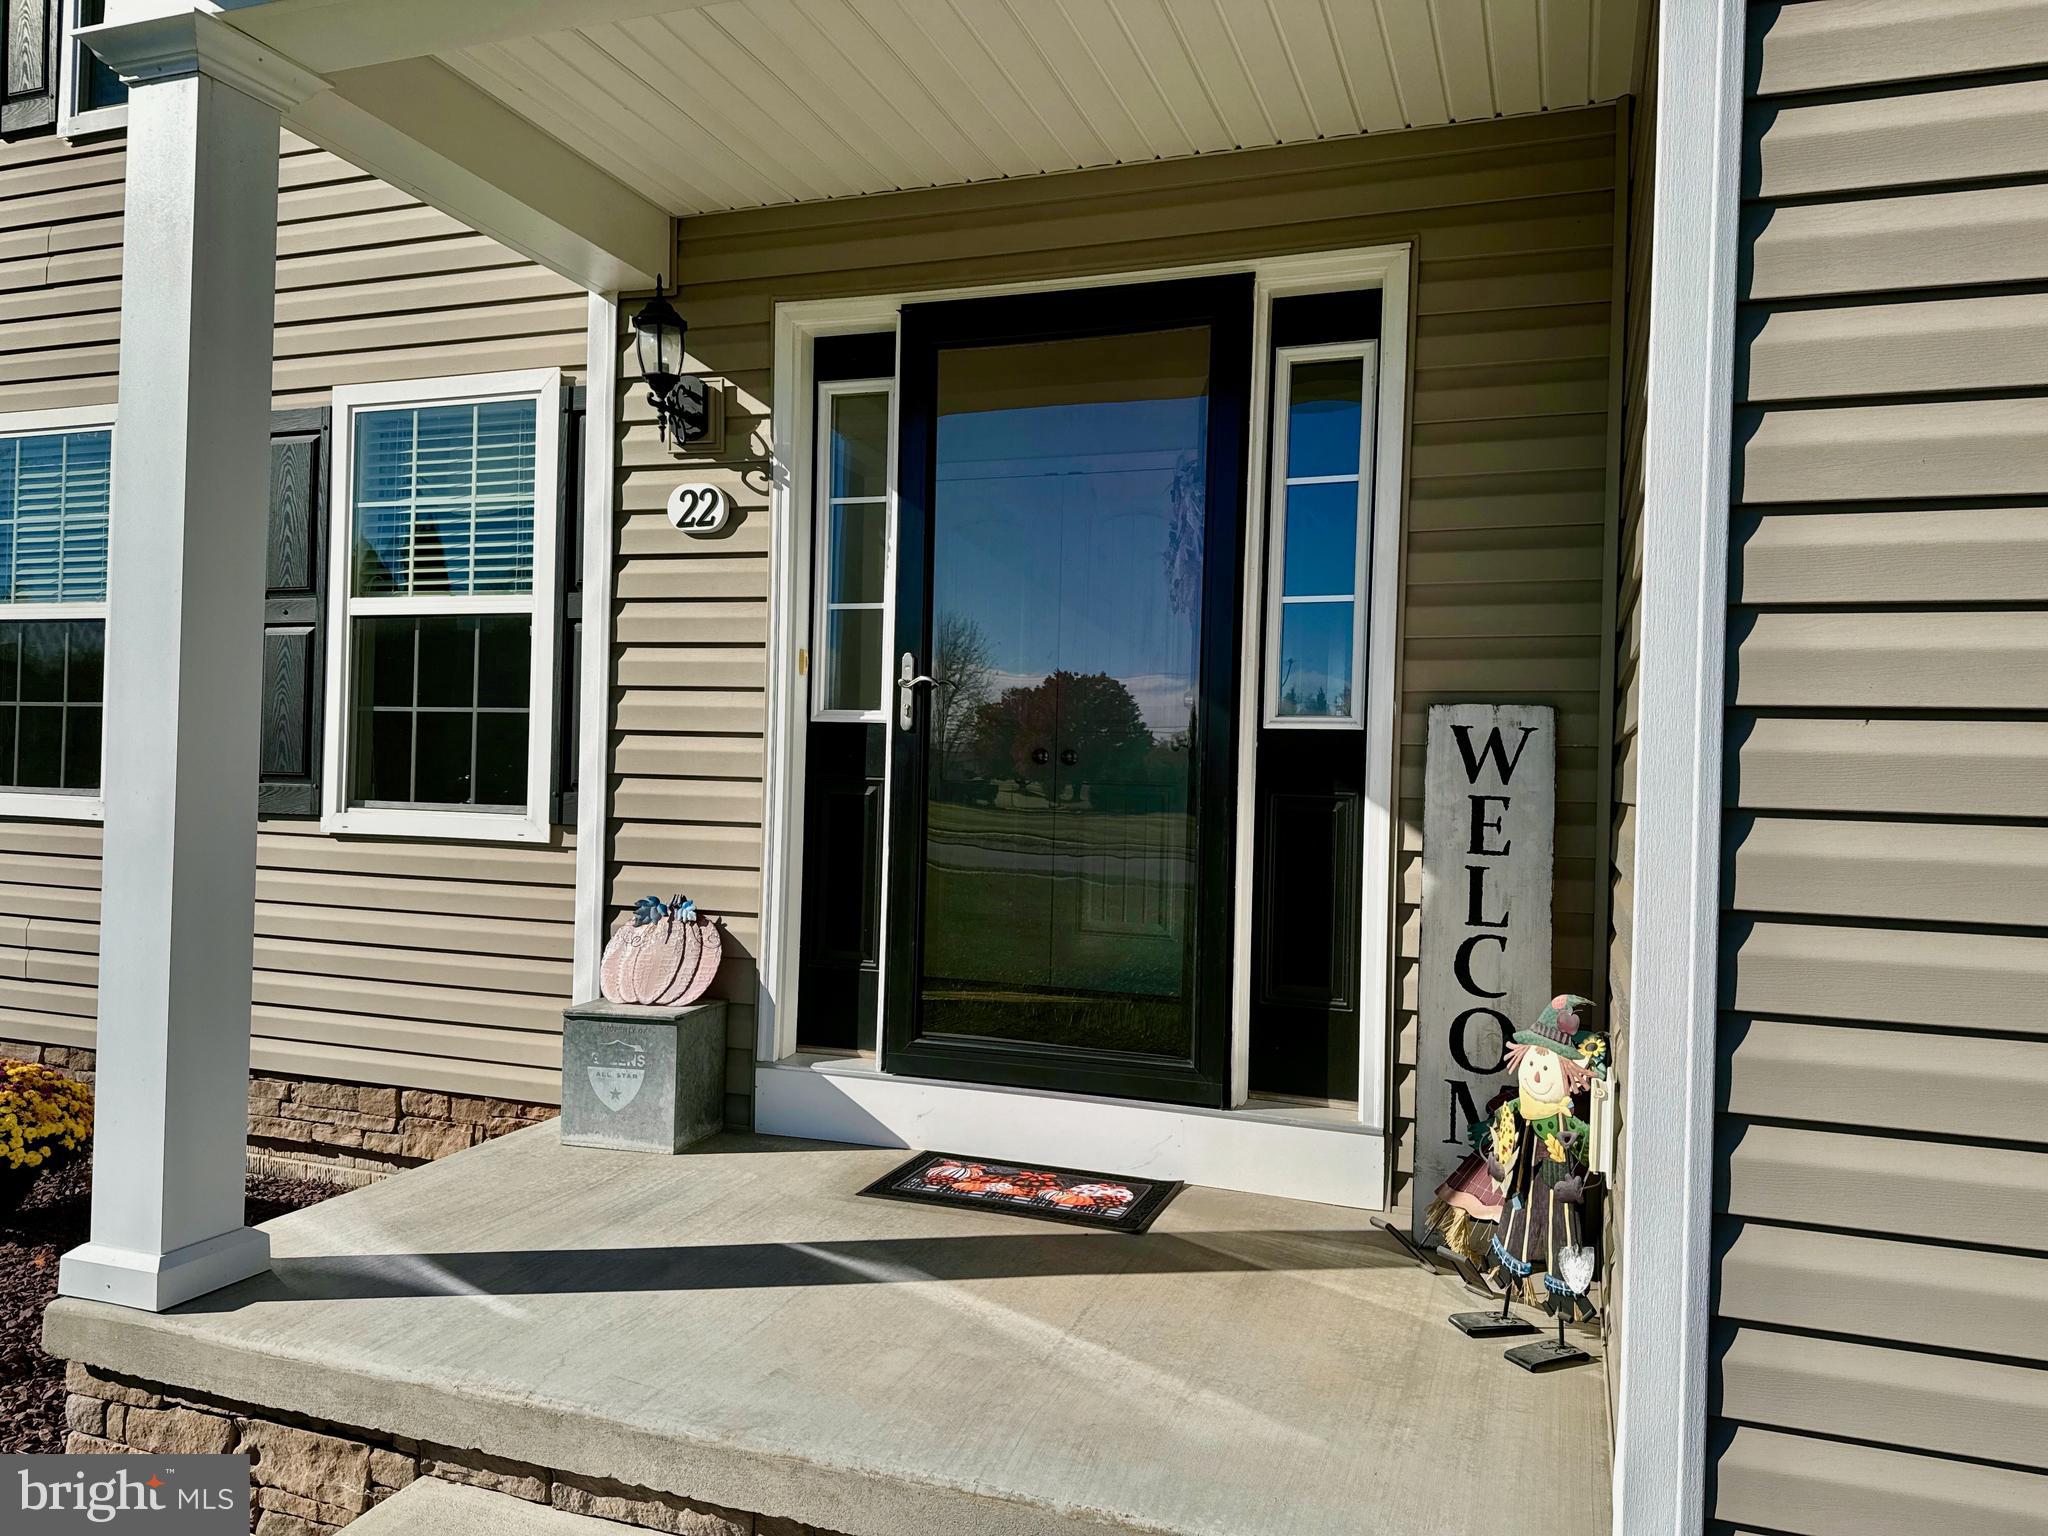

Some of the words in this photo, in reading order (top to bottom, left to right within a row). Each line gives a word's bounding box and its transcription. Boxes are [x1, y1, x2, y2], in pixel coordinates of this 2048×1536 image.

[676, 487, 720, 528] 22
[1441, 723, 1539, 1159] WELCO
[595, 1071, 612, 1079] ALL
[616, 1072, 638, 1080] STAR
